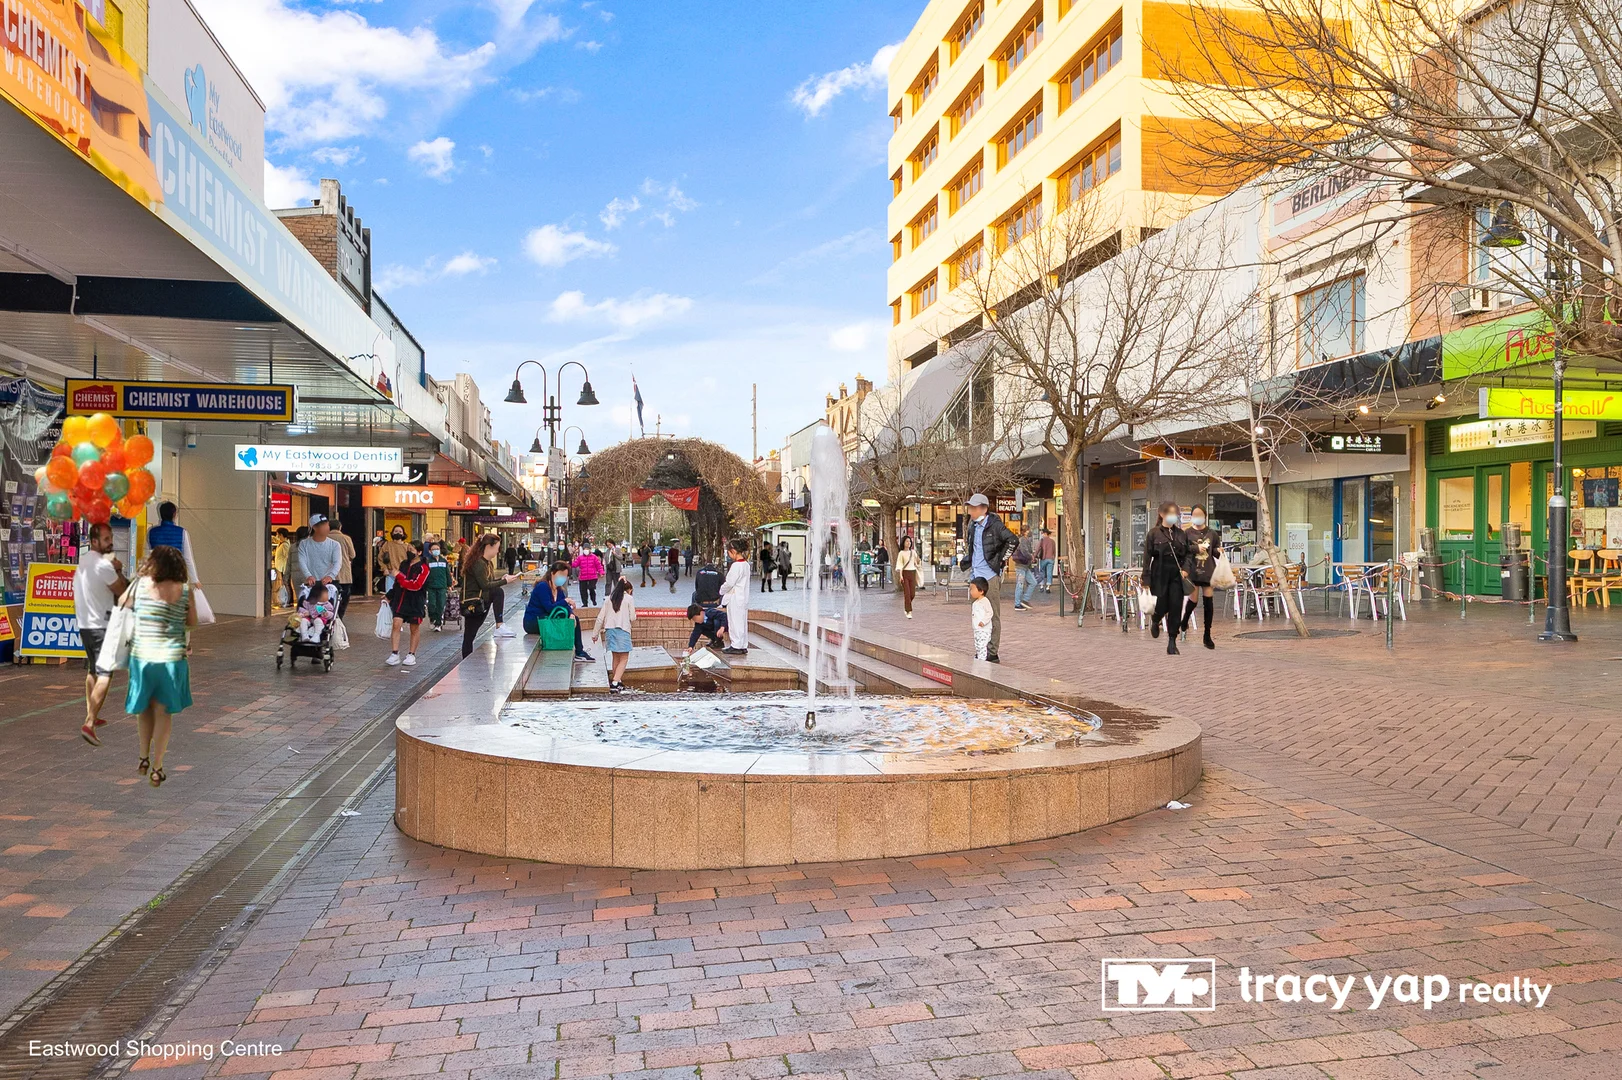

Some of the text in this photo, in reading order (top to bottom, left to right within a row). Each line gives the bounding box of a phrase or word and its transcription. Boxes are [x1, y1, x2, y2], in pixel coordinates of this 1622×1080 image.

[4, 0, 88, 106] CHEMIST
[4, 46, 85, 135] WAREHOUSE
[209, 81, 219, 112] My
[209, 107, 242, 162] Eastwood
[155, 122, 268, 276] CHEMIST
[75, 393, 116, 403] CHEMIST
[129, 391, 190, 408] CHEMIST
[196, 393, 282, 410] WAREHOUSE
[262, 449, 398, 462] My Eastwood Dentist
[395, 490, 434, 504] rma
[1289, 532, 1297, 540] For
[36, 579, 75, 591] CHEMI
[31, 616, 80, 632] NOW
[28, 631, 83, 647] OPEN
